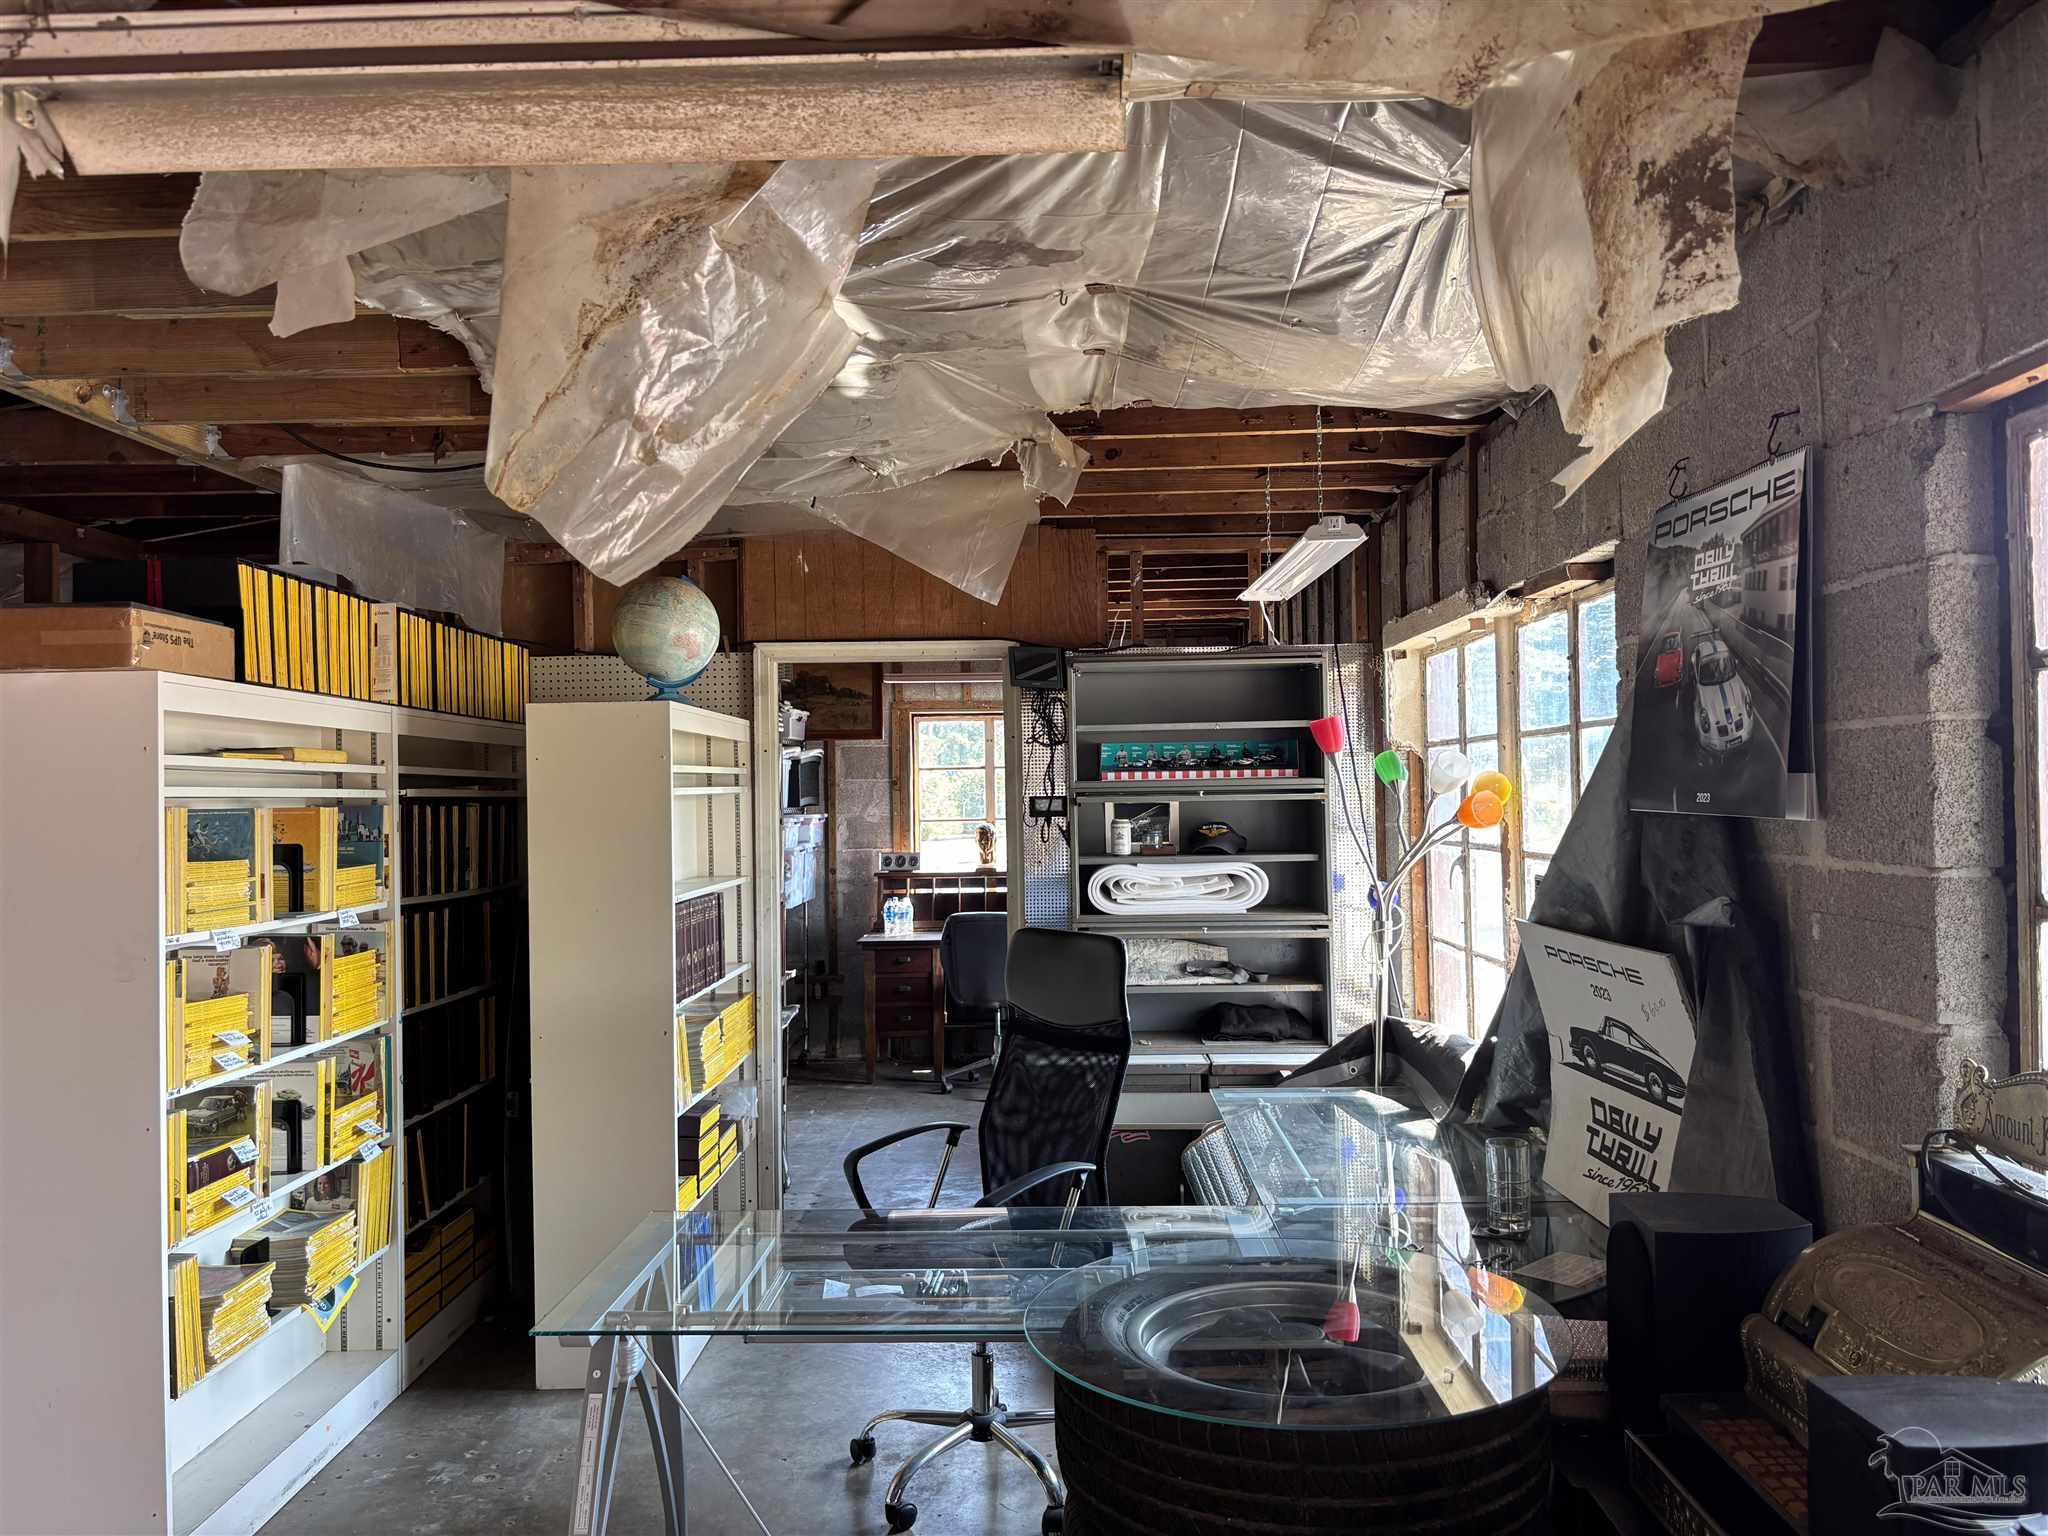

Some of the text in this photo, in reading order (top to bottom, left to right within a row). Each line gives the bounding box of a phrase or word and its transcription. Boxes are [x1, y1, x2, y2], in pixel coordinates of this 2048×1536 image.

[1655, 469, 1796, 545] PORSCHE
[1694, 539, 1736, 572] DAILY
[1690, 561, 1739, 592] THRILL
[151, 630, 194, 649] The UPS Store
[1696, 792, 1711, 803] 2023
[1544, 944, 1645, 986] PORSCHE
[1590, 983, 1613, 1002] 2023
[1590, 1096, 1663, 1154] DAILY
[1976, 1096, 2035, 1147] Amount
[1585, 1124, 1661, 1193] THRILL
[1582, 1167, 1615, 1189] since
